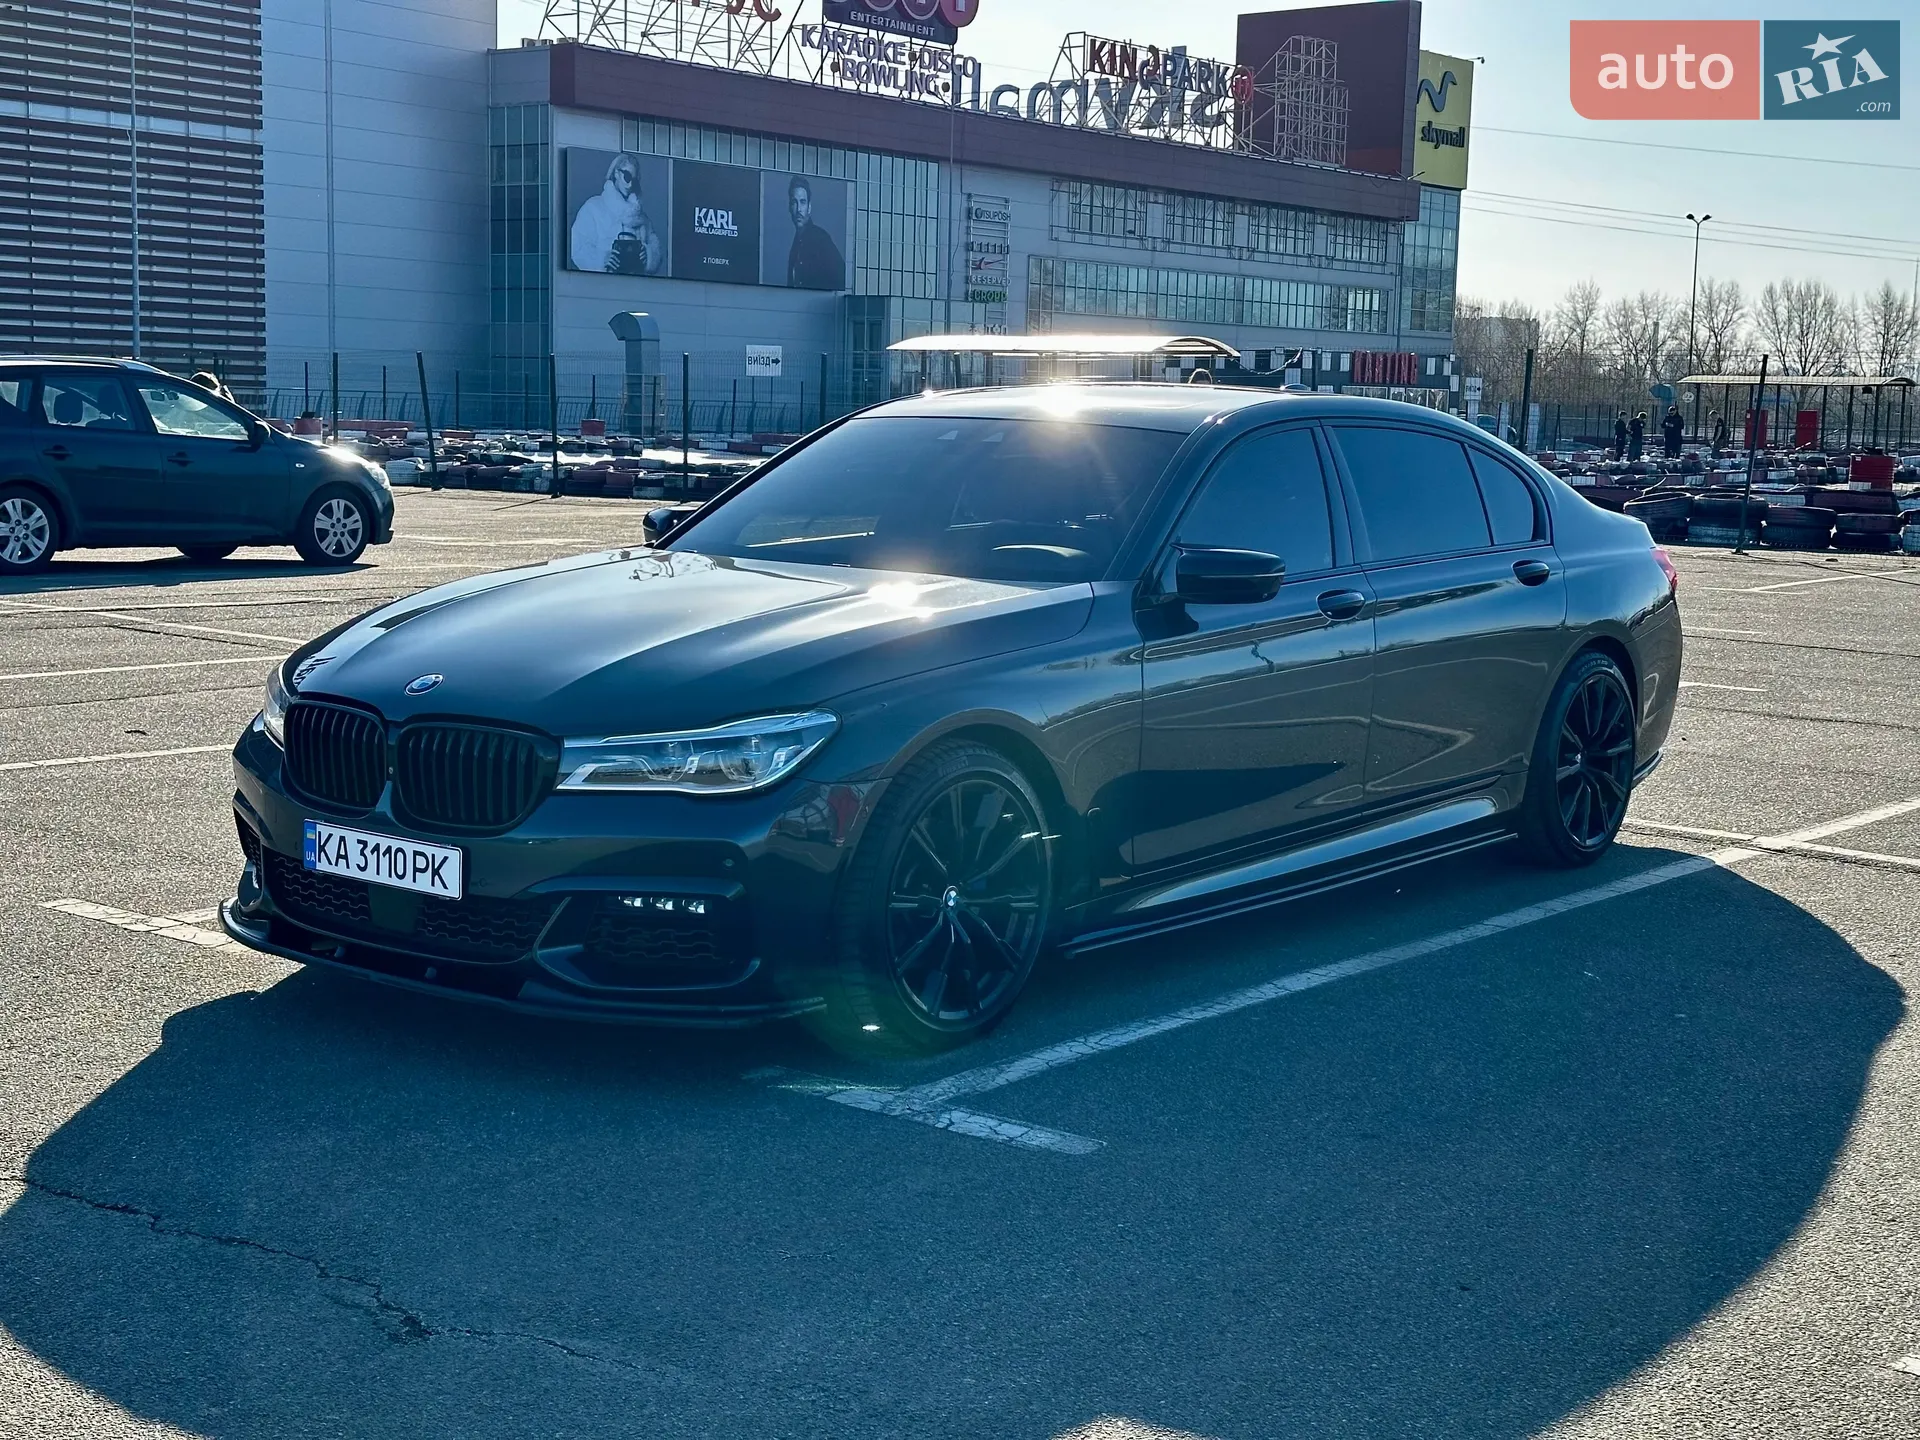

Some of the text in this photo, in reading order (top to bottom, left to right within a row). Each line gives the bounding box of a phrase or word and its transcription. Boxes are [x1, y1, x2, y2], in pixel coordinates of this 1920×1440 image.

[850, 11, 936, 37] ENTERTAINMENT
[801, 24, 977, 78] KARAOKE DISCO
[841, 58, 939, 96] BOWLING
[1421, 121, 1466, 150] skymall
[694, 206, 738, 231] KARL
[694, 226, 708, 234] KARL
[971, 275, 1011, 286] RESERVED
[317, 830, 449, 890] KA 3110 PK
